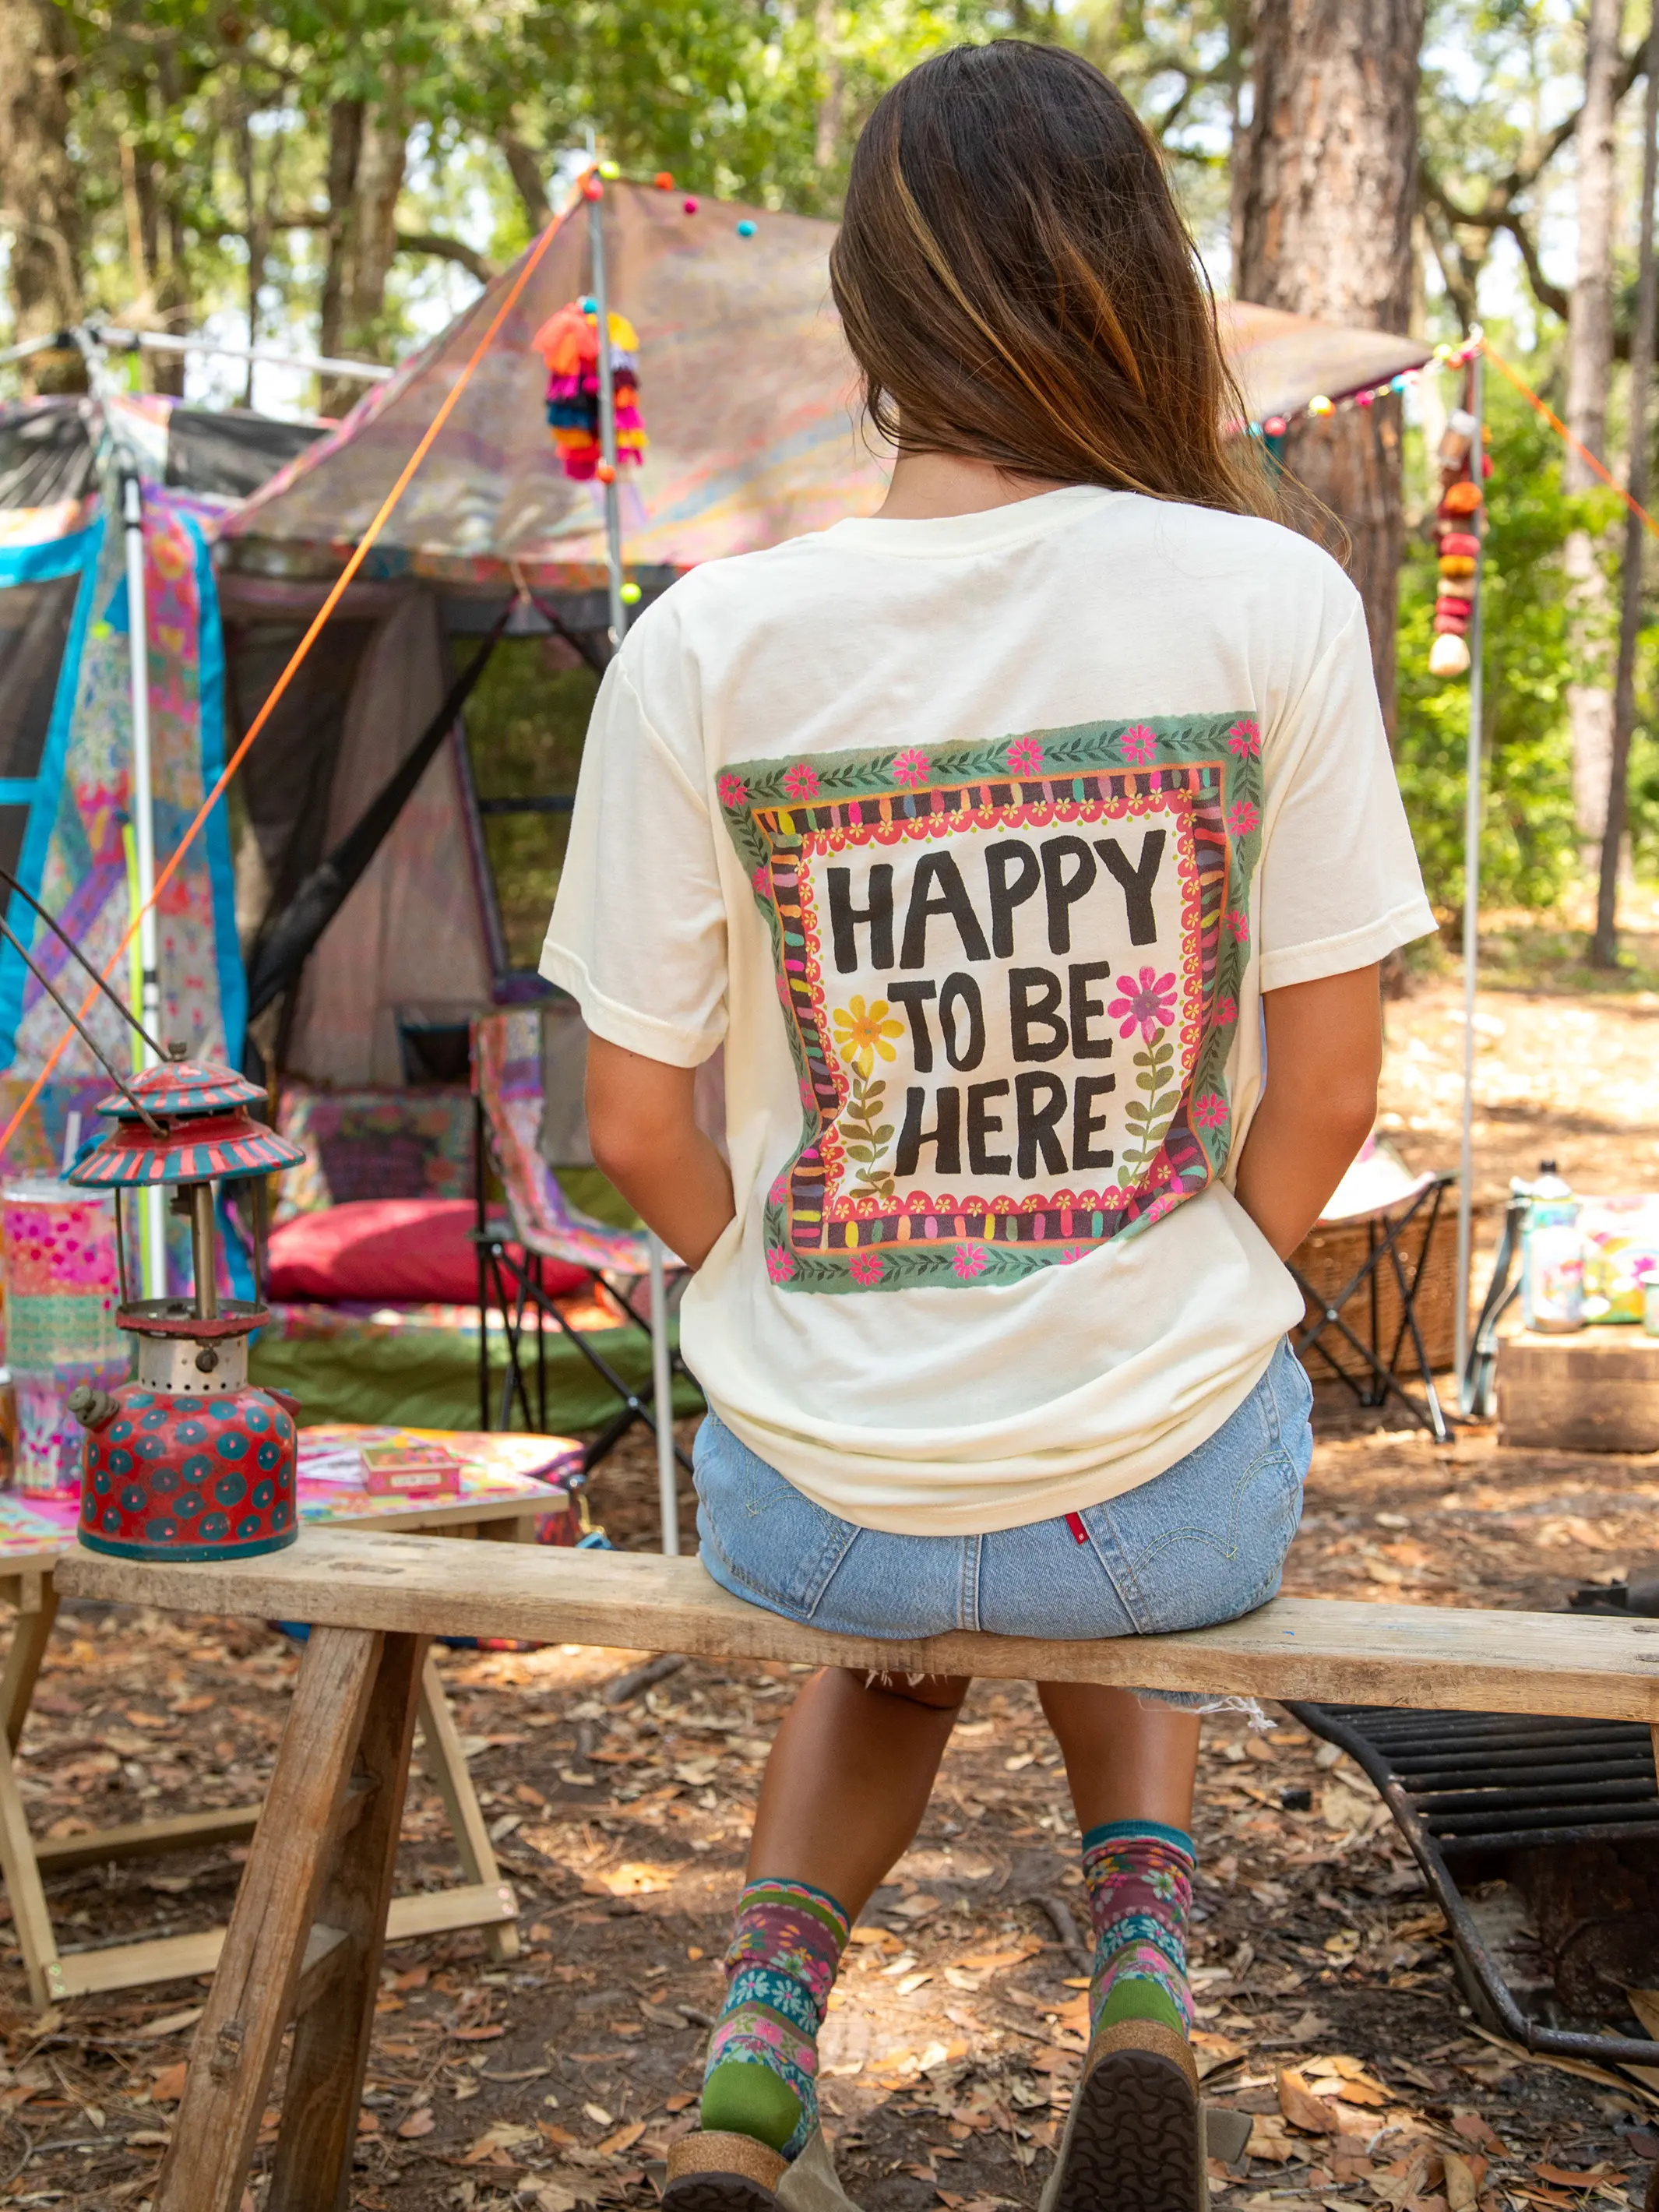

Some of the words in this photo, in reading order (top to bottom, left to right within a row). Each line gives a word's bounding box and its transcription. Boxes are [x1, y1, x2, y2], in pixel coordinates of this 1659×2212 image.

[827, 830, 1166, 974] HAPPY
[887, 972, 985, 1073] TO
[1009, 961, 1113, 1062] BE
[894, 1071, 1115, 1179] HERE
